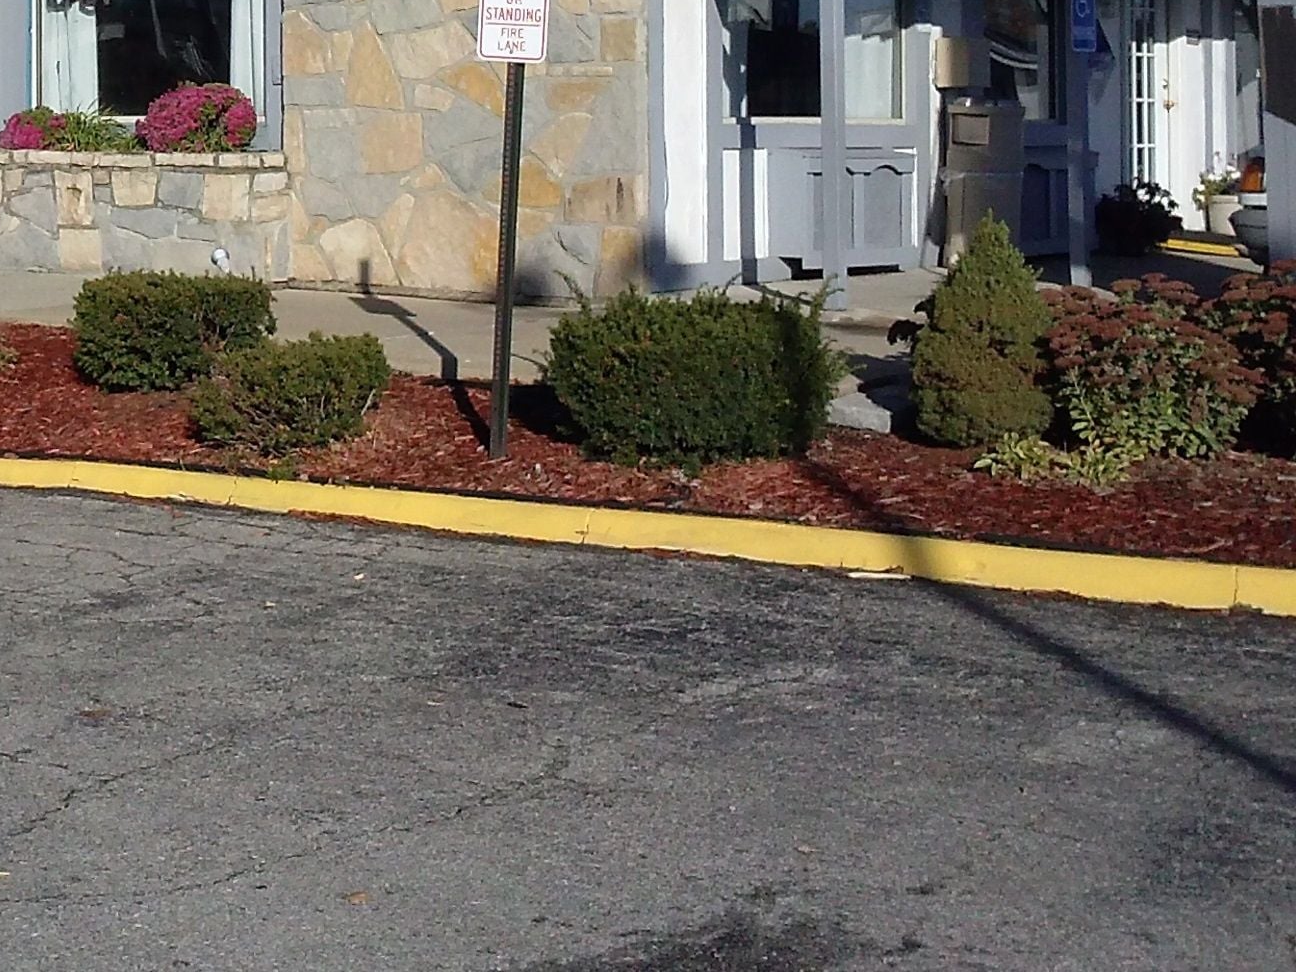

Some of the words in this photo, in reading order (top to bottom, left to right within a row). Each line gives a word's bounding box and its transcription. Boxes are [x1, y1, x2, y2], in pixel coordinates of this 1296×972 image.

[485, 7, 541, 23] STANDING
[501, 28, 524, 39] FIRE
[497, 41, 526, 52] LANE
